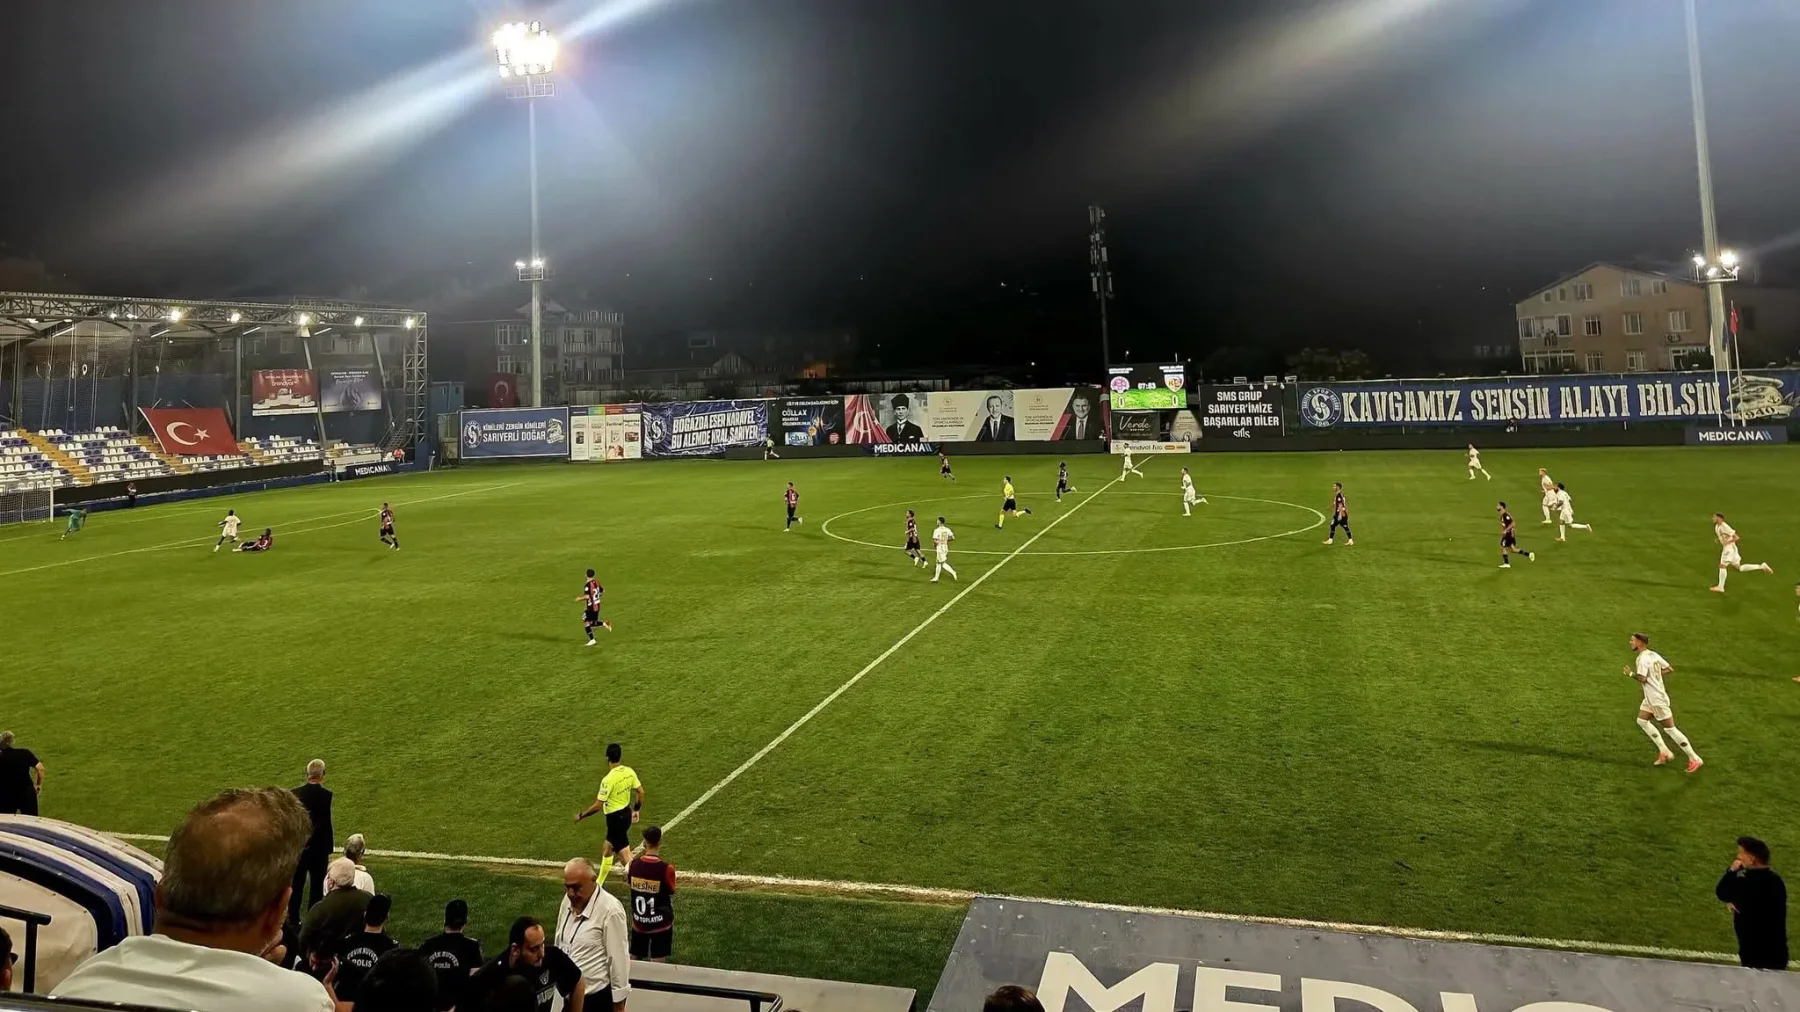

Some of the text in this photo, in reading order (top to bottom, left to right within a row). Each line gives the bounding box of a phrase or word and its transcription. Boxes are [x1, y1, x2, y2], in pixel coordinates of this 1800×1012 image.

[1216, 390, 1262, 401] SMS GRUP
[1341, 379, 1722, 422] KAVGAMIZ SENSİN ALAYI BİLSİN
[709, 413, 726, 429] ESER
[1119, 415, 1151, 430] Verde
[1203, 416, 1253, 428] BAŞARILAR
[1254, 414, 1280, 426] DİLER
[482, 429, 546, 442] SARIYERLİ DOĞAR
[671, 433, 683, 449] BU
[1698, 430, 1764, 441] MEDICANA
[874, 443, 925, 453] MEDICANA
[354, 465, 388, 476] MEDICANA
[635, 896, 655, 915] 01
